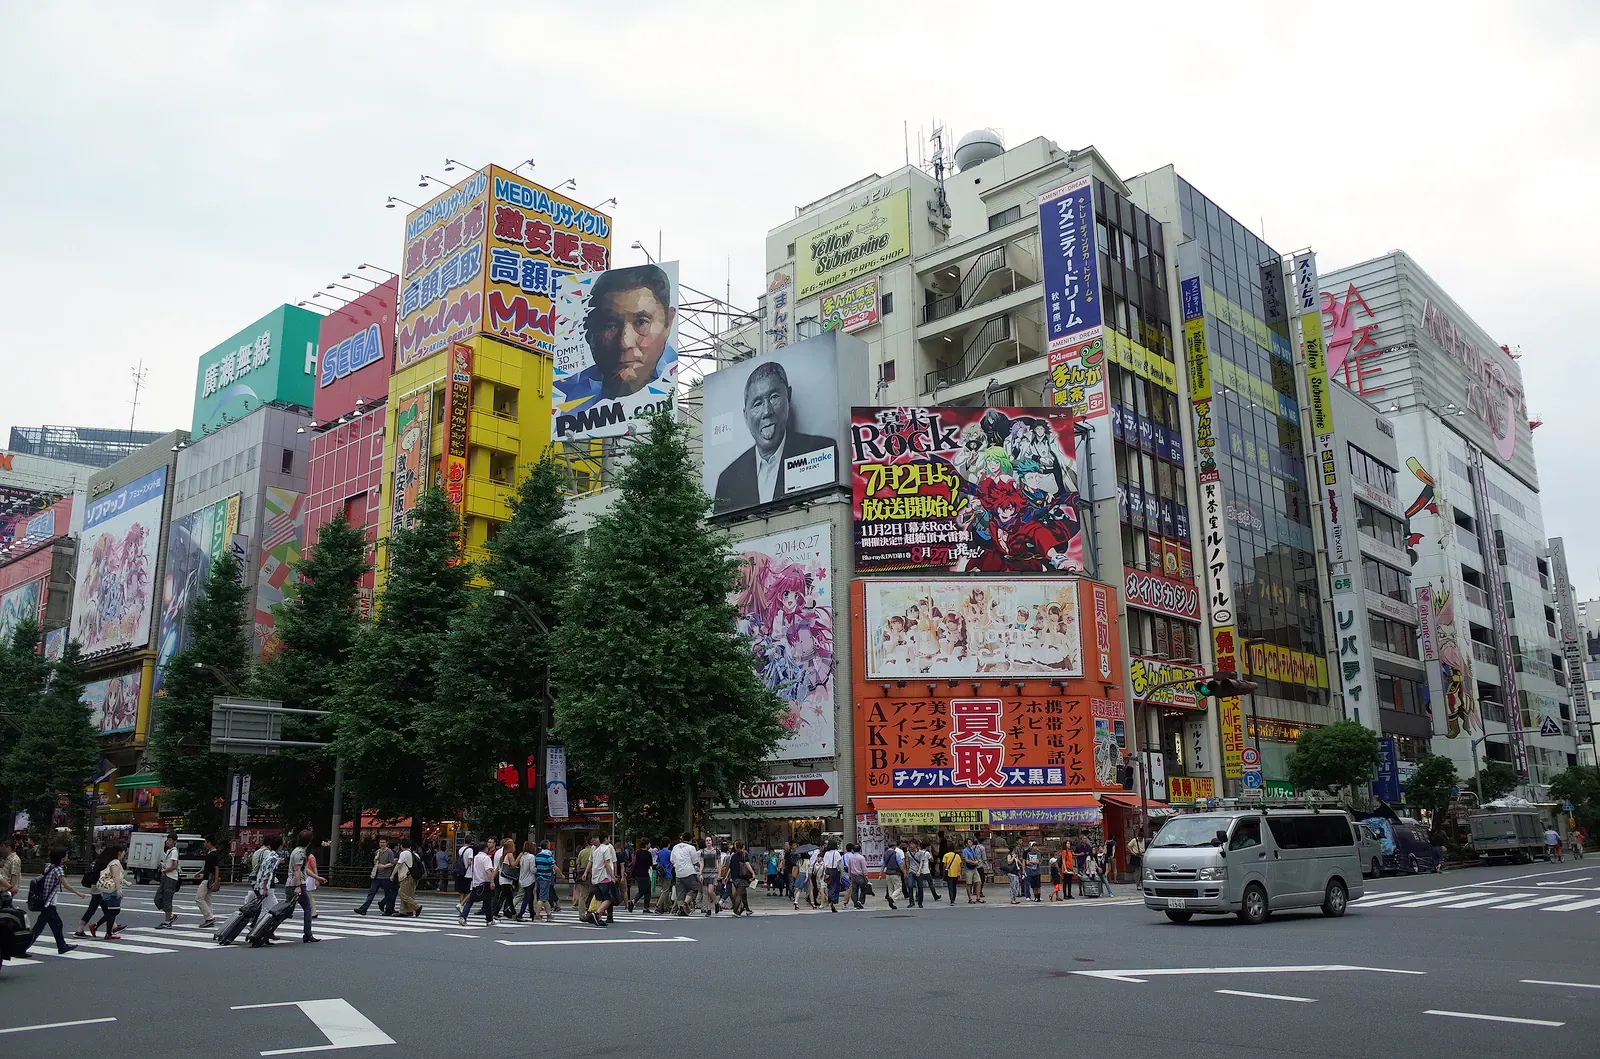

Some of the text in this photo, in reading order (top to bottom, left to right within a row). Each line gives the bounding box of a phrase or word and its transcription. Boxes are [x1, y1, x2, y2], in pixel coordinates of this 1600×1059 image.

[407, 172, 487, 241] MEDIAリサイクル
[495, 177, 608, 237] MEDIAリサイクル
[1042, 178, 1088, 202] AMENITY DREAM
[405, 202, 485, 279] 激安販売
[494, 206, 606, 271] 激安販売
[810, 230, 854, 261] Yellow
[815, 233, 890, 276] Submarine
[402, 242, 482, 319] 高額買取
[1057, 197, 1083, 330] アメニティードリーム
[823, 283, 875, 315] まんが喫茶
[1299, 259, 1314, 308] スーパービル
[399, 290, 481, 364] Mulan
[1051, 292, 1063, 333] 秋葉原店
[500, 326, 537, 346] ムーラン
[557, 346, 579, 357] DMM
[1052, 328, 1100, 349] AMENITY DREAM
[202, 331, 271, 398] 廣瀬無線
[320, 323, 384, 388] SEGA
[558, 355, 569, 366] 3D
[558, 361, 579, 372] PRINT
[1307, 338, 1318, 370] Yellow
[454, 383, 468, 393] DVD
[1052, 362, 1102, 388] まんが
[455, 407, 464, 416] CD
[1053, 386, 1085, 406] 喫茶
[1311, 377, 1325, 429] Submarine
[877, 409, 930, 435] 幕末
[1196, 402, 1211, 438] まんが
[852, 414, 962, 463] Rock
[1171, 448, 1181, 461] 6F
[1320, 435, 1331, 443] 5F
[787, 452, 832, 470] DMM.make
[860, 463, 960, 496] 7月2日より
[88, 490, 127, 524] ソフマップ
[775, 535, 819, 555] 2014.6.27
[862, 523, 902, 537] 11月2日
[1178, 524, 1187, 537] 5F
[1126, 573, 1197, 615] メイドカジノ
[1335, 579, 1351, 590] 6号
[1094, 590, 1110, 652] 買取
[1102, 656, 1108, 673] 入口
[1131, 659, 1195, 696] まんが喫茶
[1338, 610, 1361, 723] リバティー
[867, 701, 888, 769] AKB
[892, 701, 910, 764] アイドル
[910, 701, 928, 748] アニメ
[928, 701, 949, 767] 美少女系
[1008, 701, 1027, 766] フィギュア
[1026, 701, 1042, 746] ホビー
[1046, 701, 1065, 765] 携帯電話
[1221, 697, 1235, 752] 세점
[1233, 715, 1244, 751] FREE
[952, 701, 1005, 786] 買取
[1064, 700, 1086, 785] アップルとか
[1192, 730, 1204, 769] ルノアール
[1245, 752, 1255, 761] 40
[787, 782, 806, 796] ZIN
[868, 771, 889, 786] もの
[894, 770, 950, 787] チケット
[1010, 769, 1063, 785] 大黒屋
[1172, 778, 1192, 797] 免税
[1247, 775, 1255, 787] P
[1267, 787, 1294, 798] リバティー
